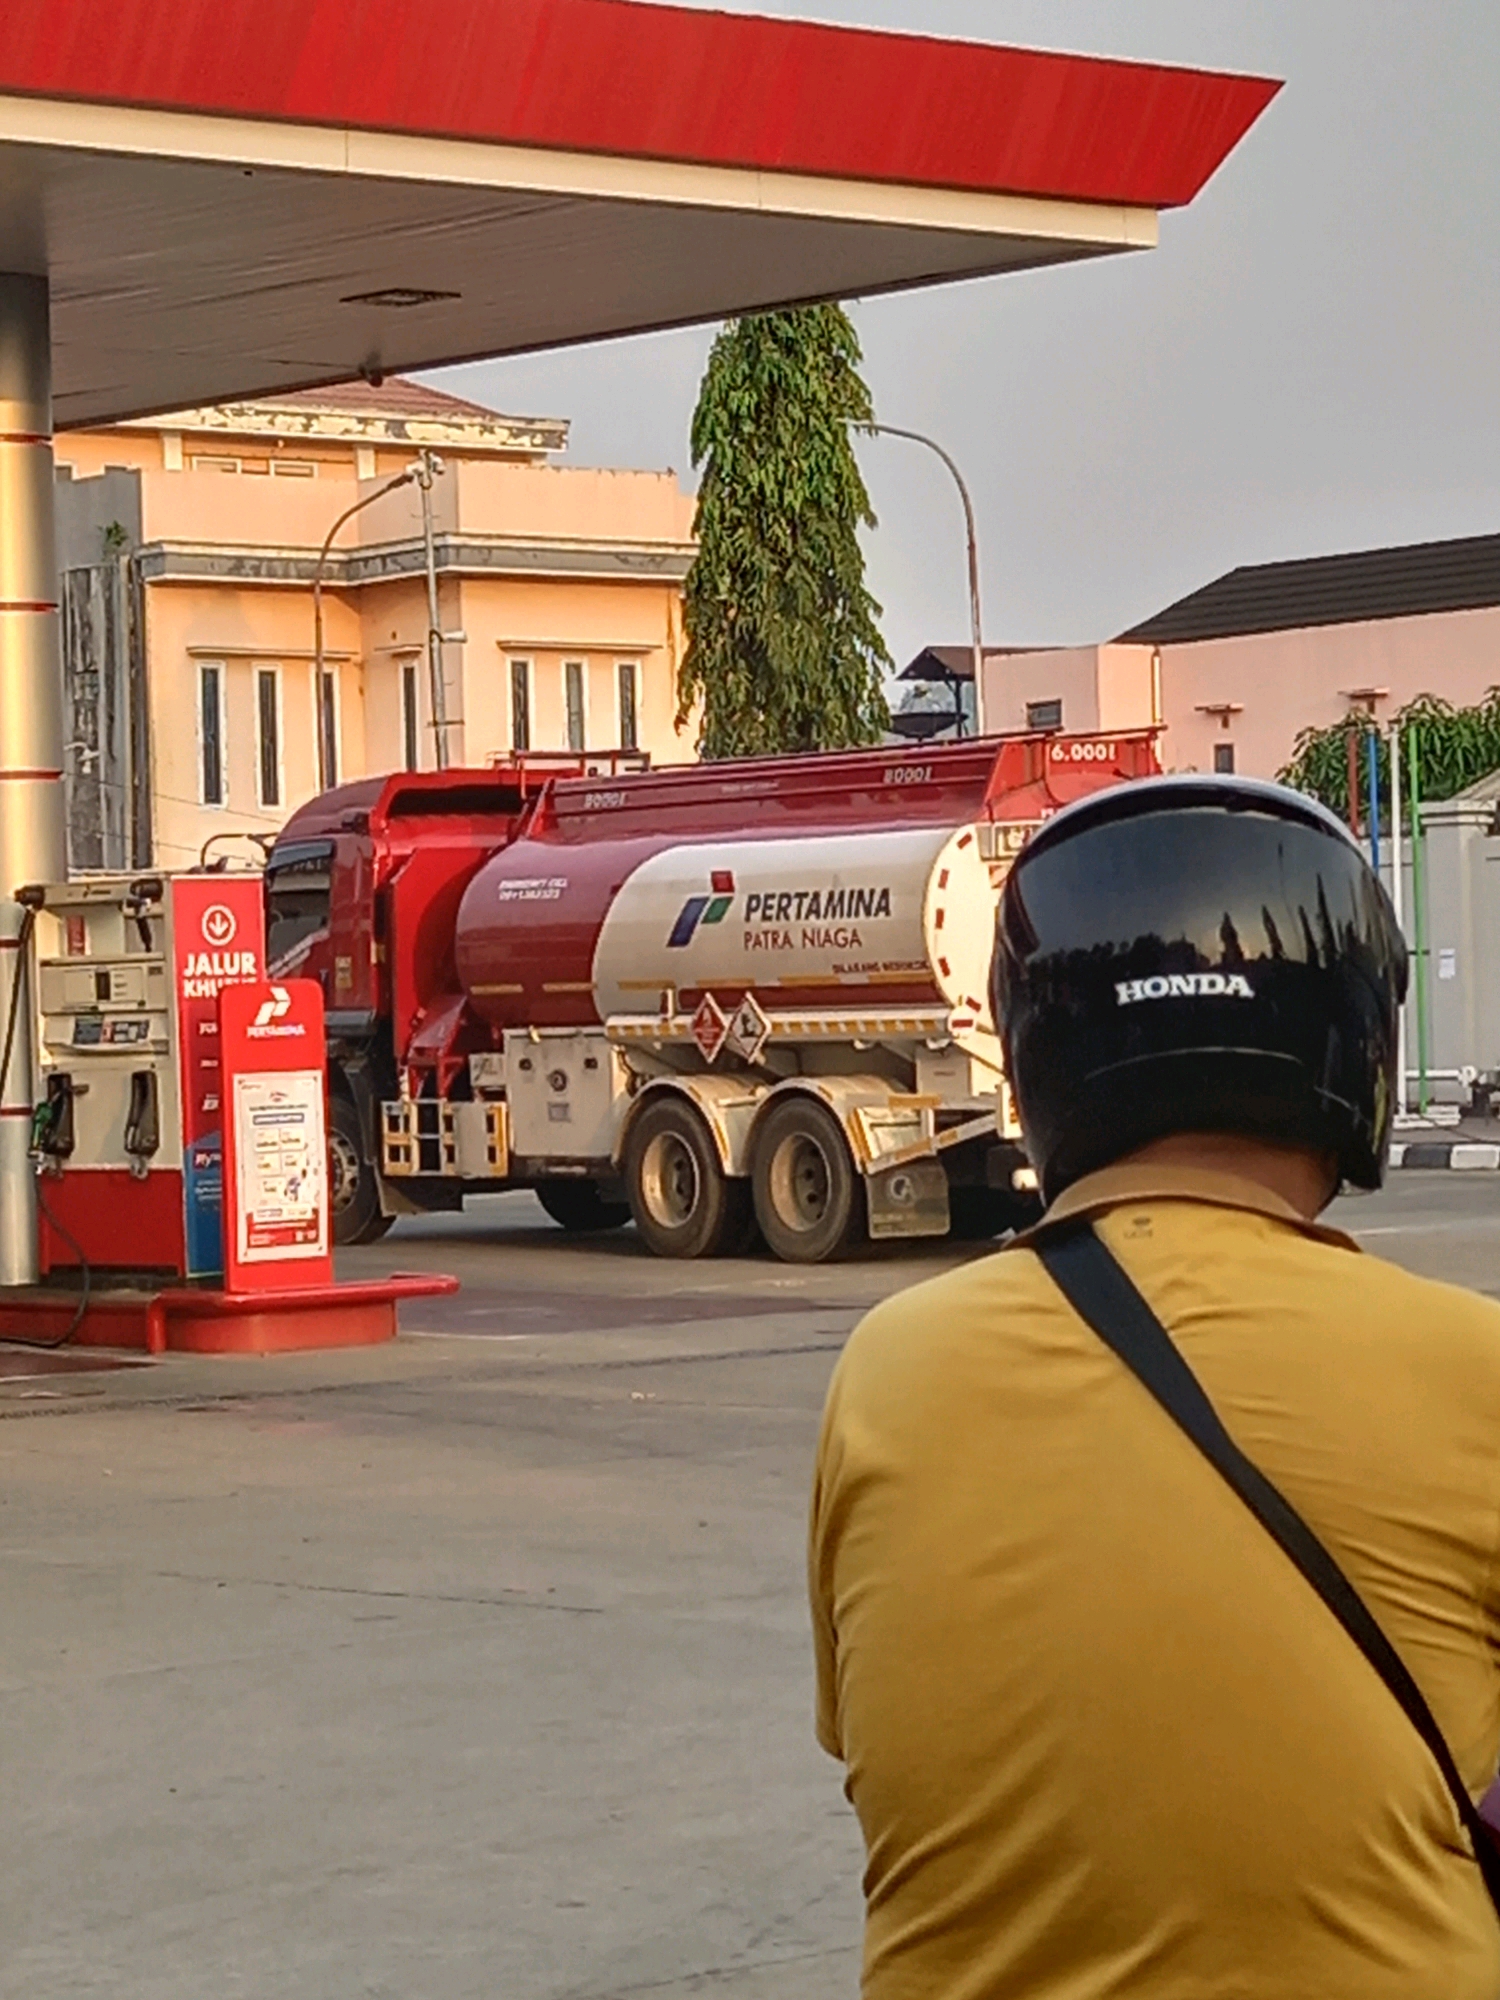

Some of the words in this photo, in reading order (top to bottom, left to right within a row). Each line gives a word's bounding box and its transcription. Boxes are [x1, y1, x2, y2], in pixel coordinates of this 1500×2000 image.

[744, 887, 891, 923] PERTAMINA
[744, 930, 794, 951] PATRA
[801, 927, 862, 949] NIAGA
[183, 951, 257, 977] JALUR
[1114, 973, 1255, 1006] HONDA
